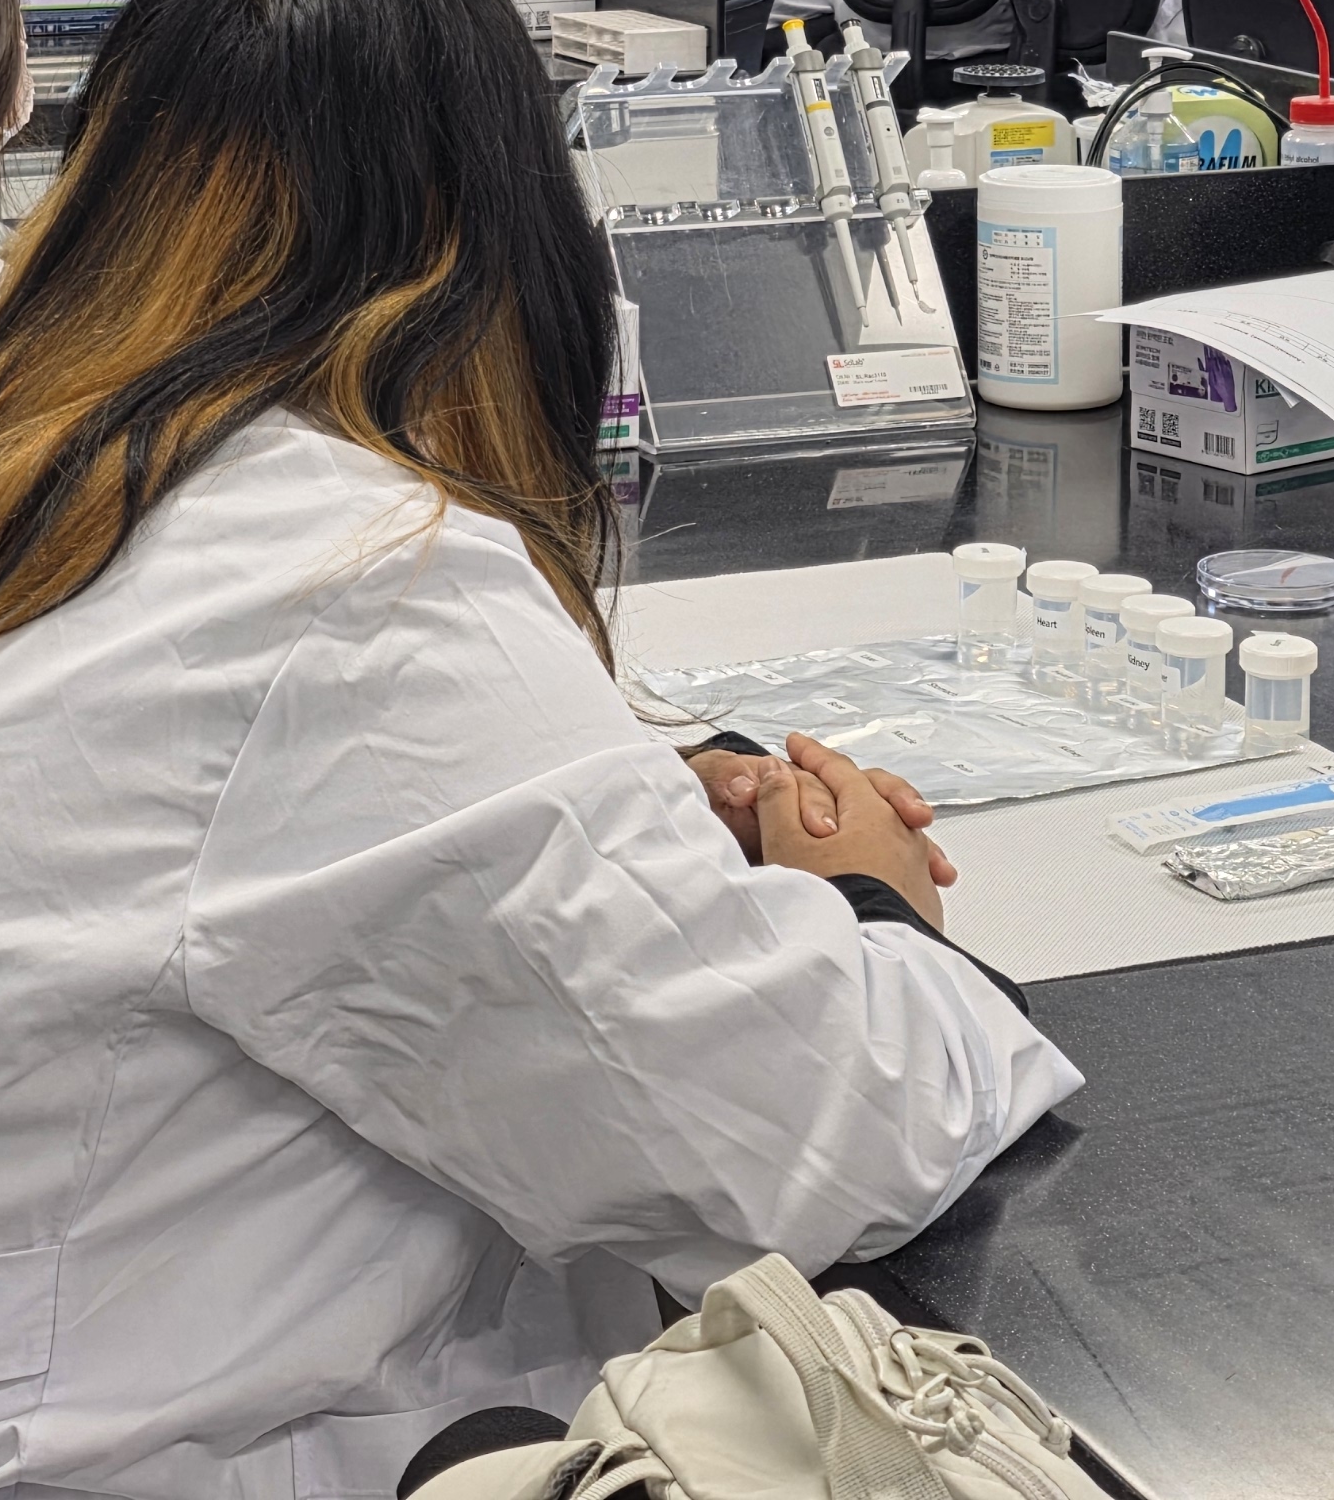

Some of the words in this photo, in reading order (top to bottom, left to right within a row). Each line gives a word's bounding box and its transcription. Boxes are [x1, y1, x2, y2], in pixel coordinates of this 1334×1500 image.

[1198, 155, 1257, 171] RAFILM
[1295, 155, 1320, 164] alcohol
[1036, 615, 1058, 630] Heart
